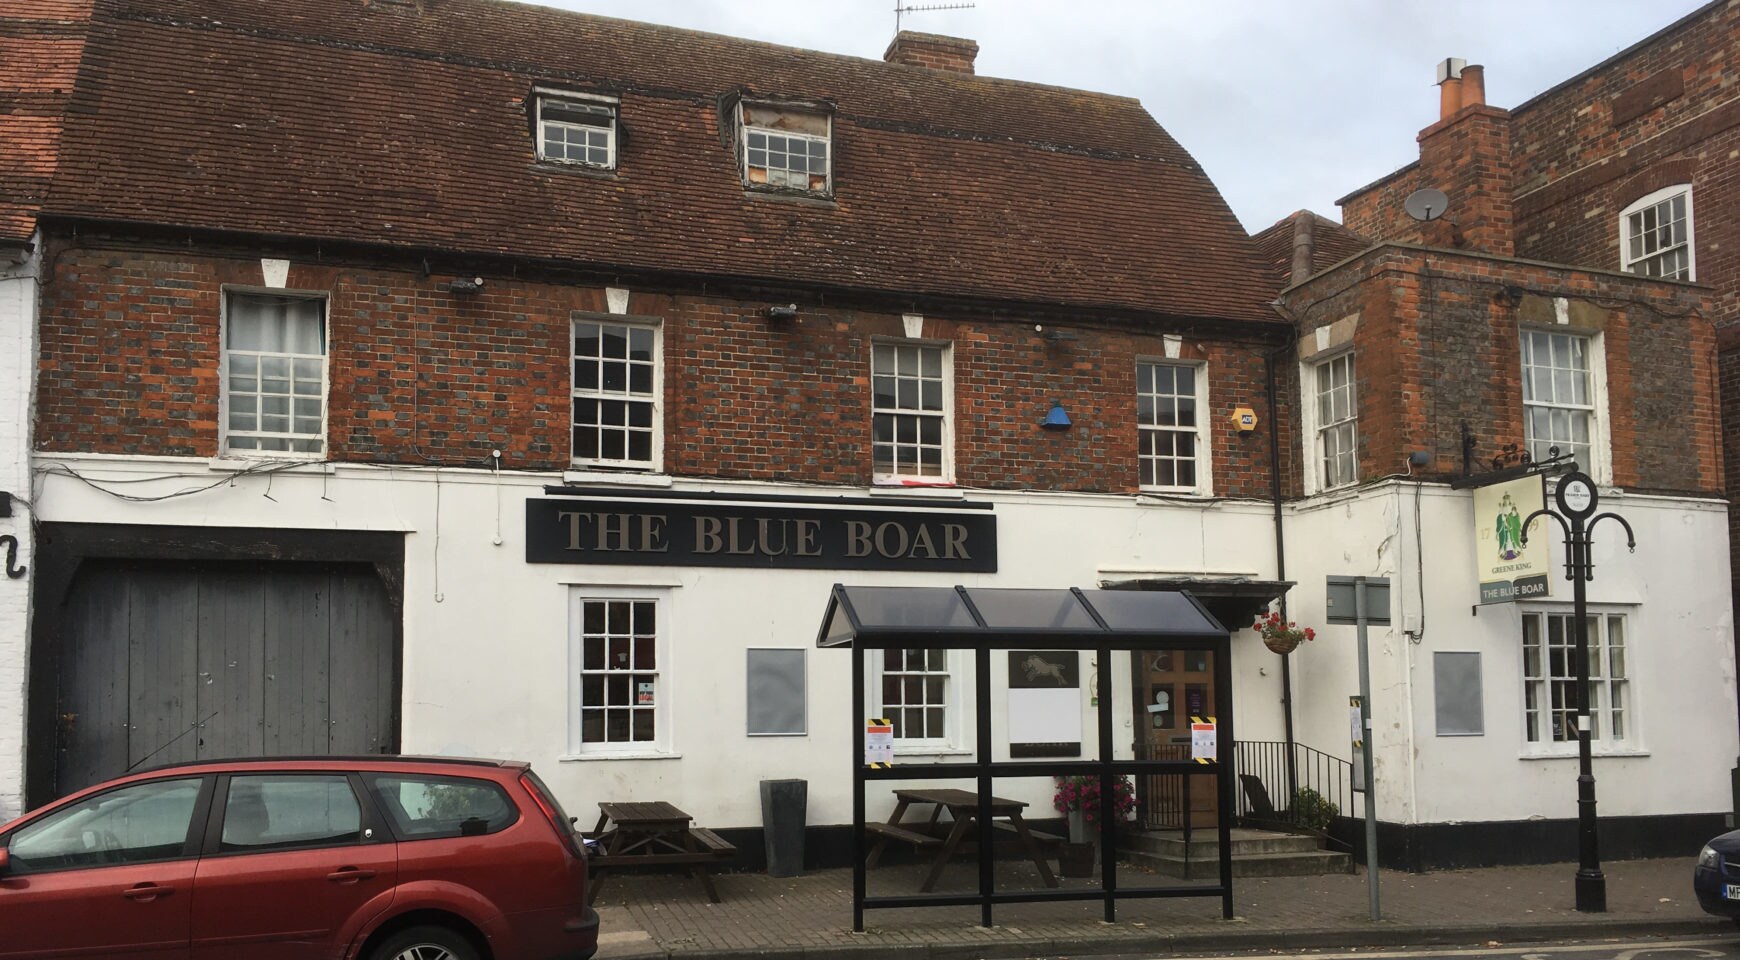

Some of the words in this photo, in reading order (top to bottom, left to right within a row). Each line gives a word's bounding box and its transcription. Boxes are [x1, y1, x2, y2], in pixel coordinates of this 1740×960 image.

[558, 511, 669, 552] THE
[692, 515, 823, 557] BLUE
[843, 520, 972, 560] BOAR
[1480, 527, 1491, 540] 17
[1491, 564, 1515, 574] GREENE
[1515, 562, 1532, 571] KING
[1483, 589, 1498, 598] THE
[1500, 586, 1520, 597] BLUE
[1521, 583, 1544, 594] BOAR
